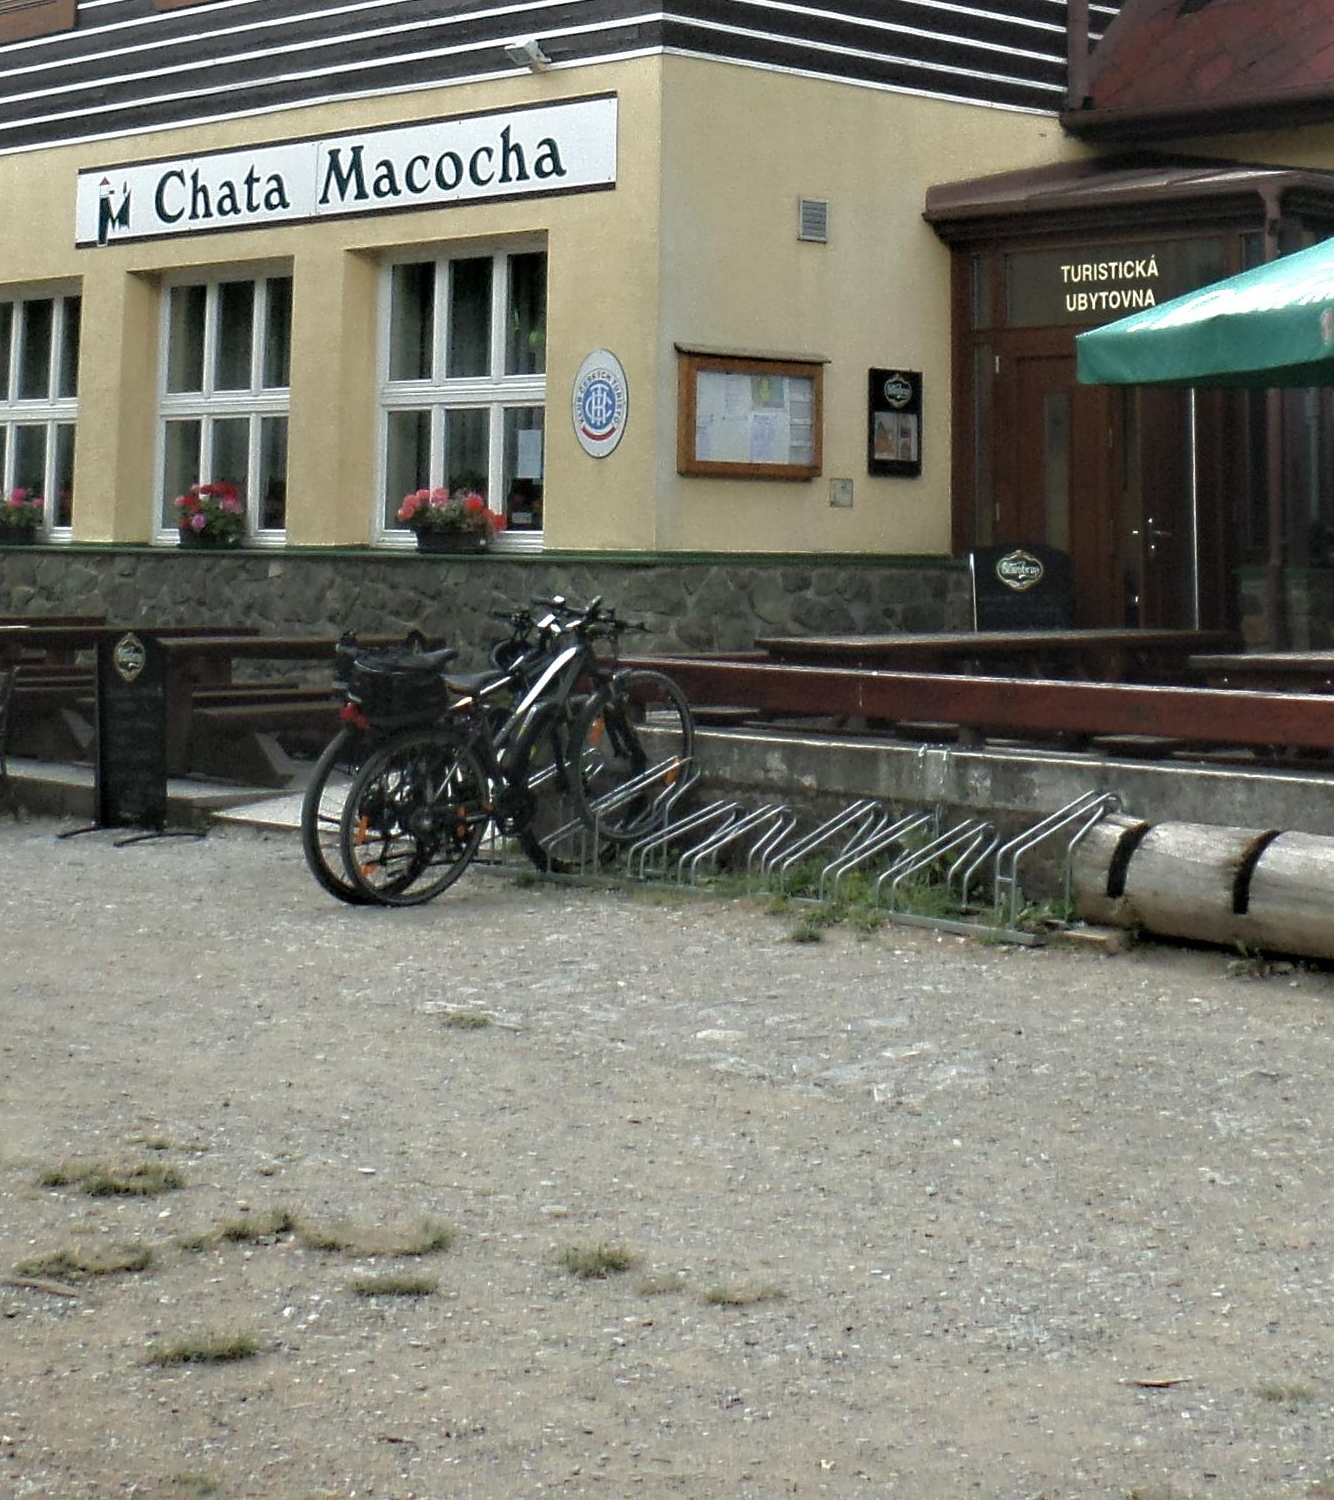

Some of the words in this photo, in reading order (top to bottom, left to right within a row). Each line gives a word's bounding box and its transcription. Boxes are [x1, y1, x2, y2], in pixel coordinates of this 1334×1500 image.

[154, 164, 291, 224] Chata
[318, 124, 567, 205] Macocha
[1060, 254, 1159, 283] TURISTICKÁ
[1066, 288, 1156, 312] UBYTOVNA
